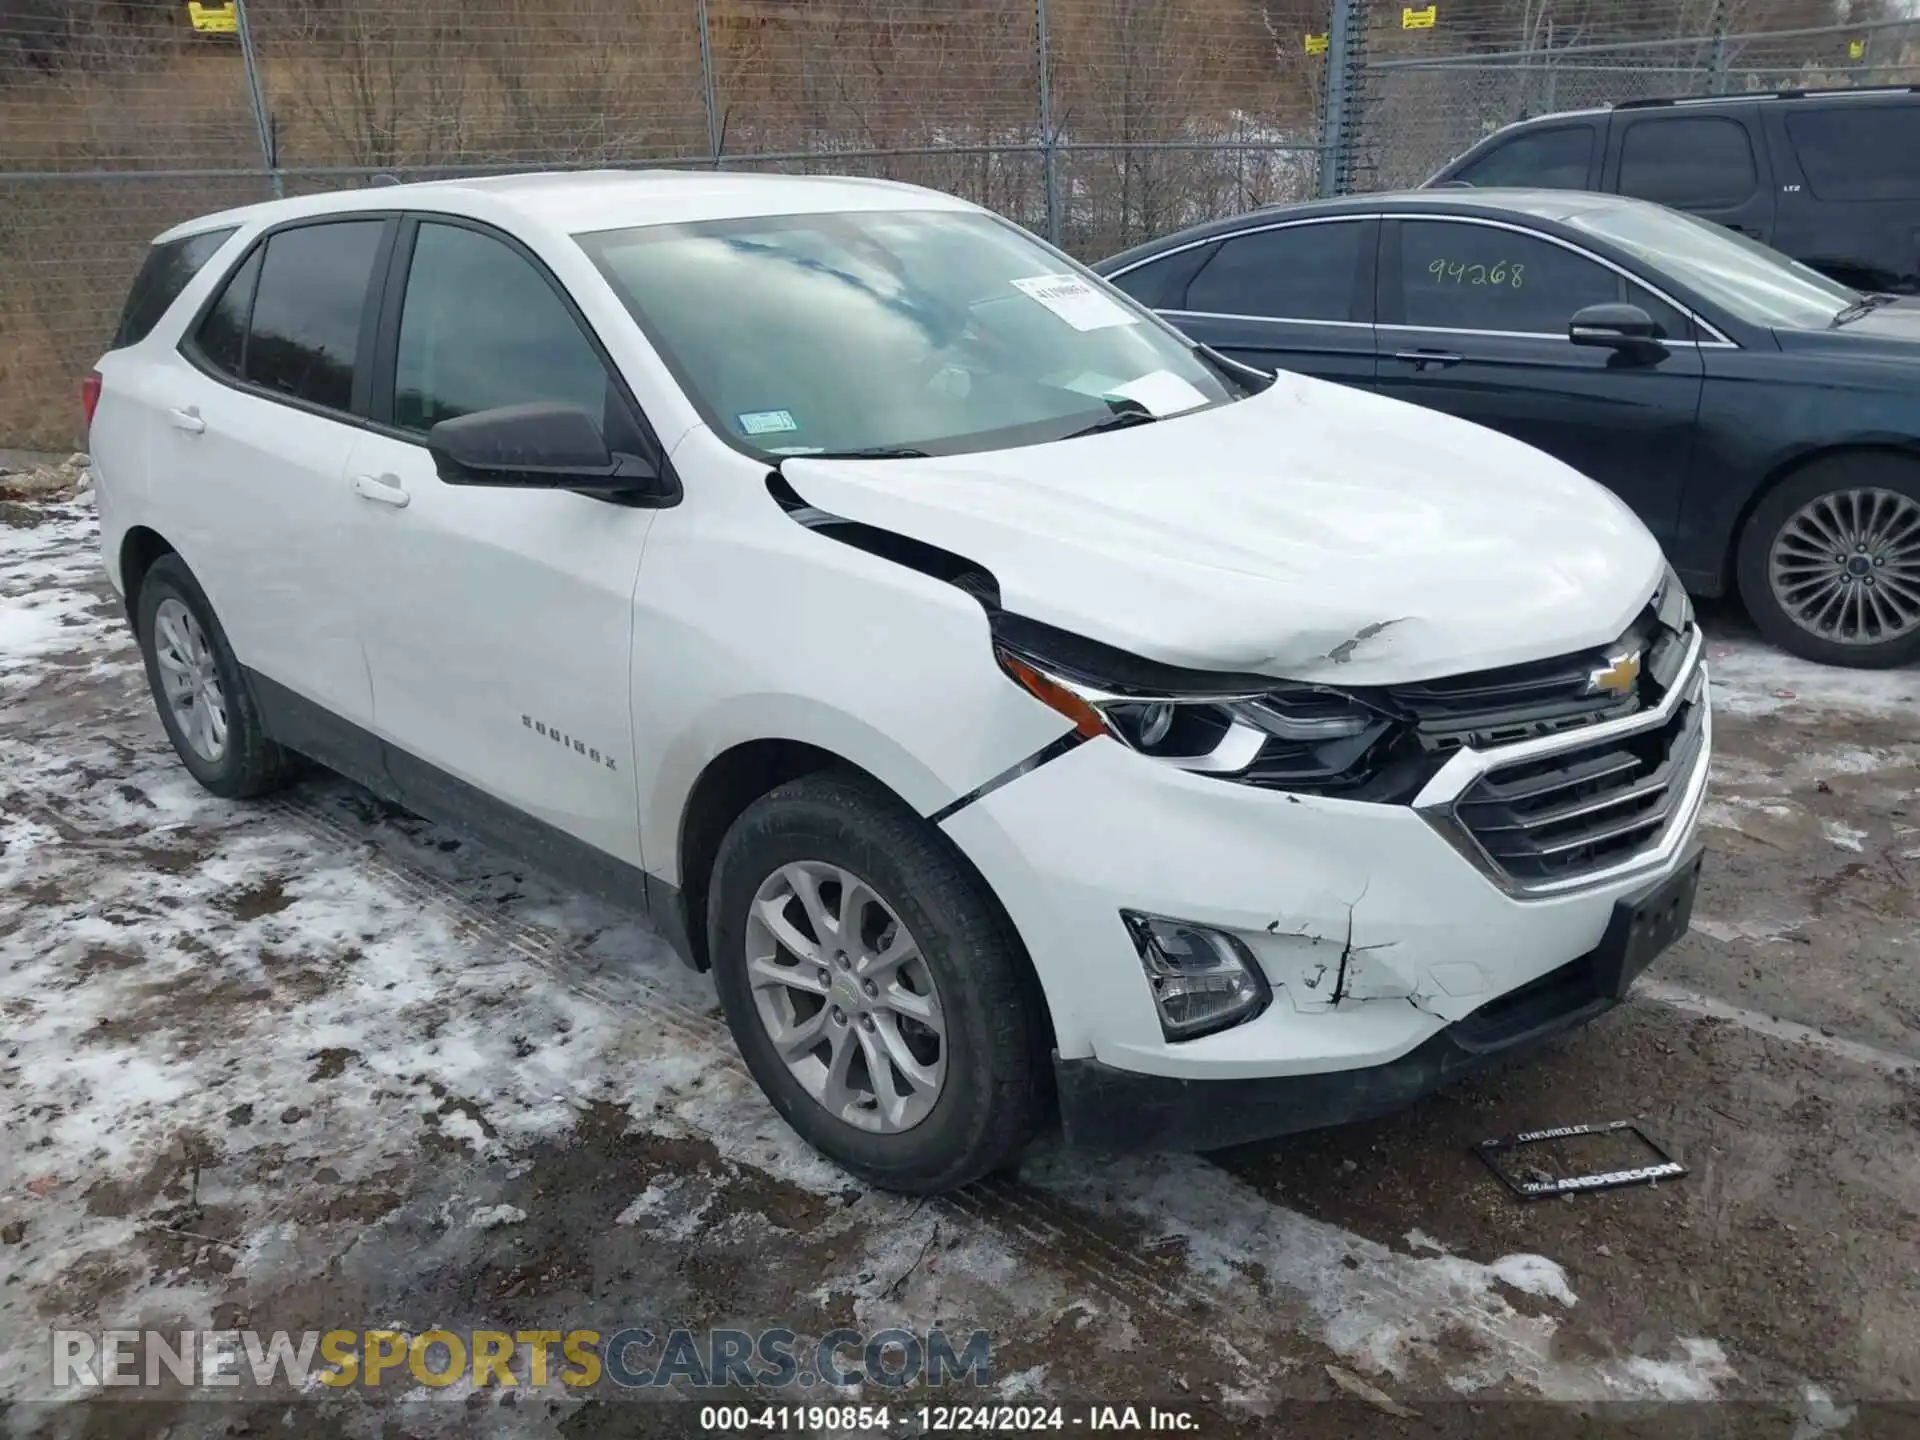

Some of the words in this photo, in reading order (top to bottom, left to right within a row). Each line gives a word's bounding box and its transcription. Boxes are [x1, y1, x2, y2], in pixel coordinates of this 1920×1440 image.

[1428, 258, 1524, 288] 94268
[521, 714, 617, 772] EQUINOX
[1517, 1124, 1590, 1141] CHEVROLET
[1558, 1162, 1683, 1189] ANDERSON
